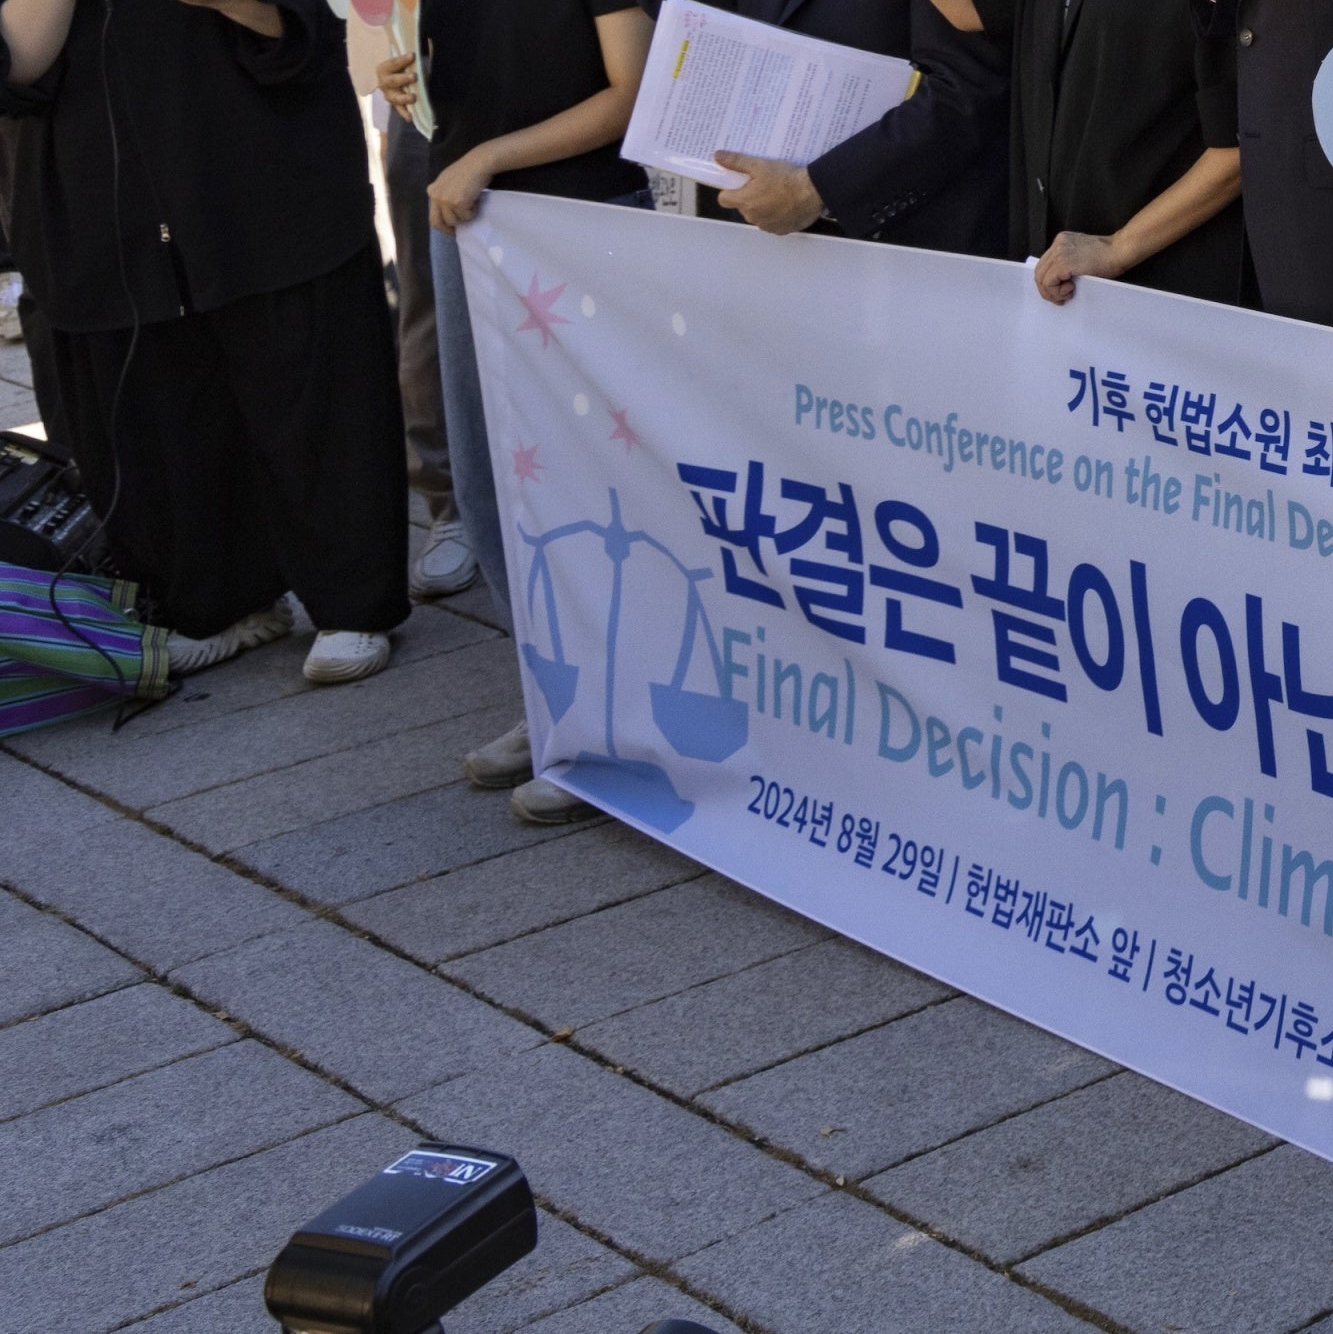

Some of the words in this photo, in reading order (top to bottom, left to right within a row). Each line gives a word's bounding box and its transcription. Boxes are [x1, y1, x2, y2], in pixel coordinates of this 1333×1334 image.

[794, 383, 876, 441] Press
[884, 404, 1064, 478] Conference
[1073, 454, 1114, 498] on
[1124, 455, 1182, 515] the
[1192, 473, 1275, 542] Final
[1067, 366, 1135, 433] 기후
[1143, 381, 1291, 475] 헌법소원
[676, 459, 964, 665] 판결은
[970, 520, 1163, 737] 끝이
[722, 626, 855, 746] Final
[876, 680, 1129, 851] Decision
[748, 775, 833, 848] 2024년
[837, 815, 880, 869] 8월
[881, 834, 944, 897] 29일
[965, 863, 1102, 963] 헌법재판소
[1108, 926, 1141, 984] 앞
